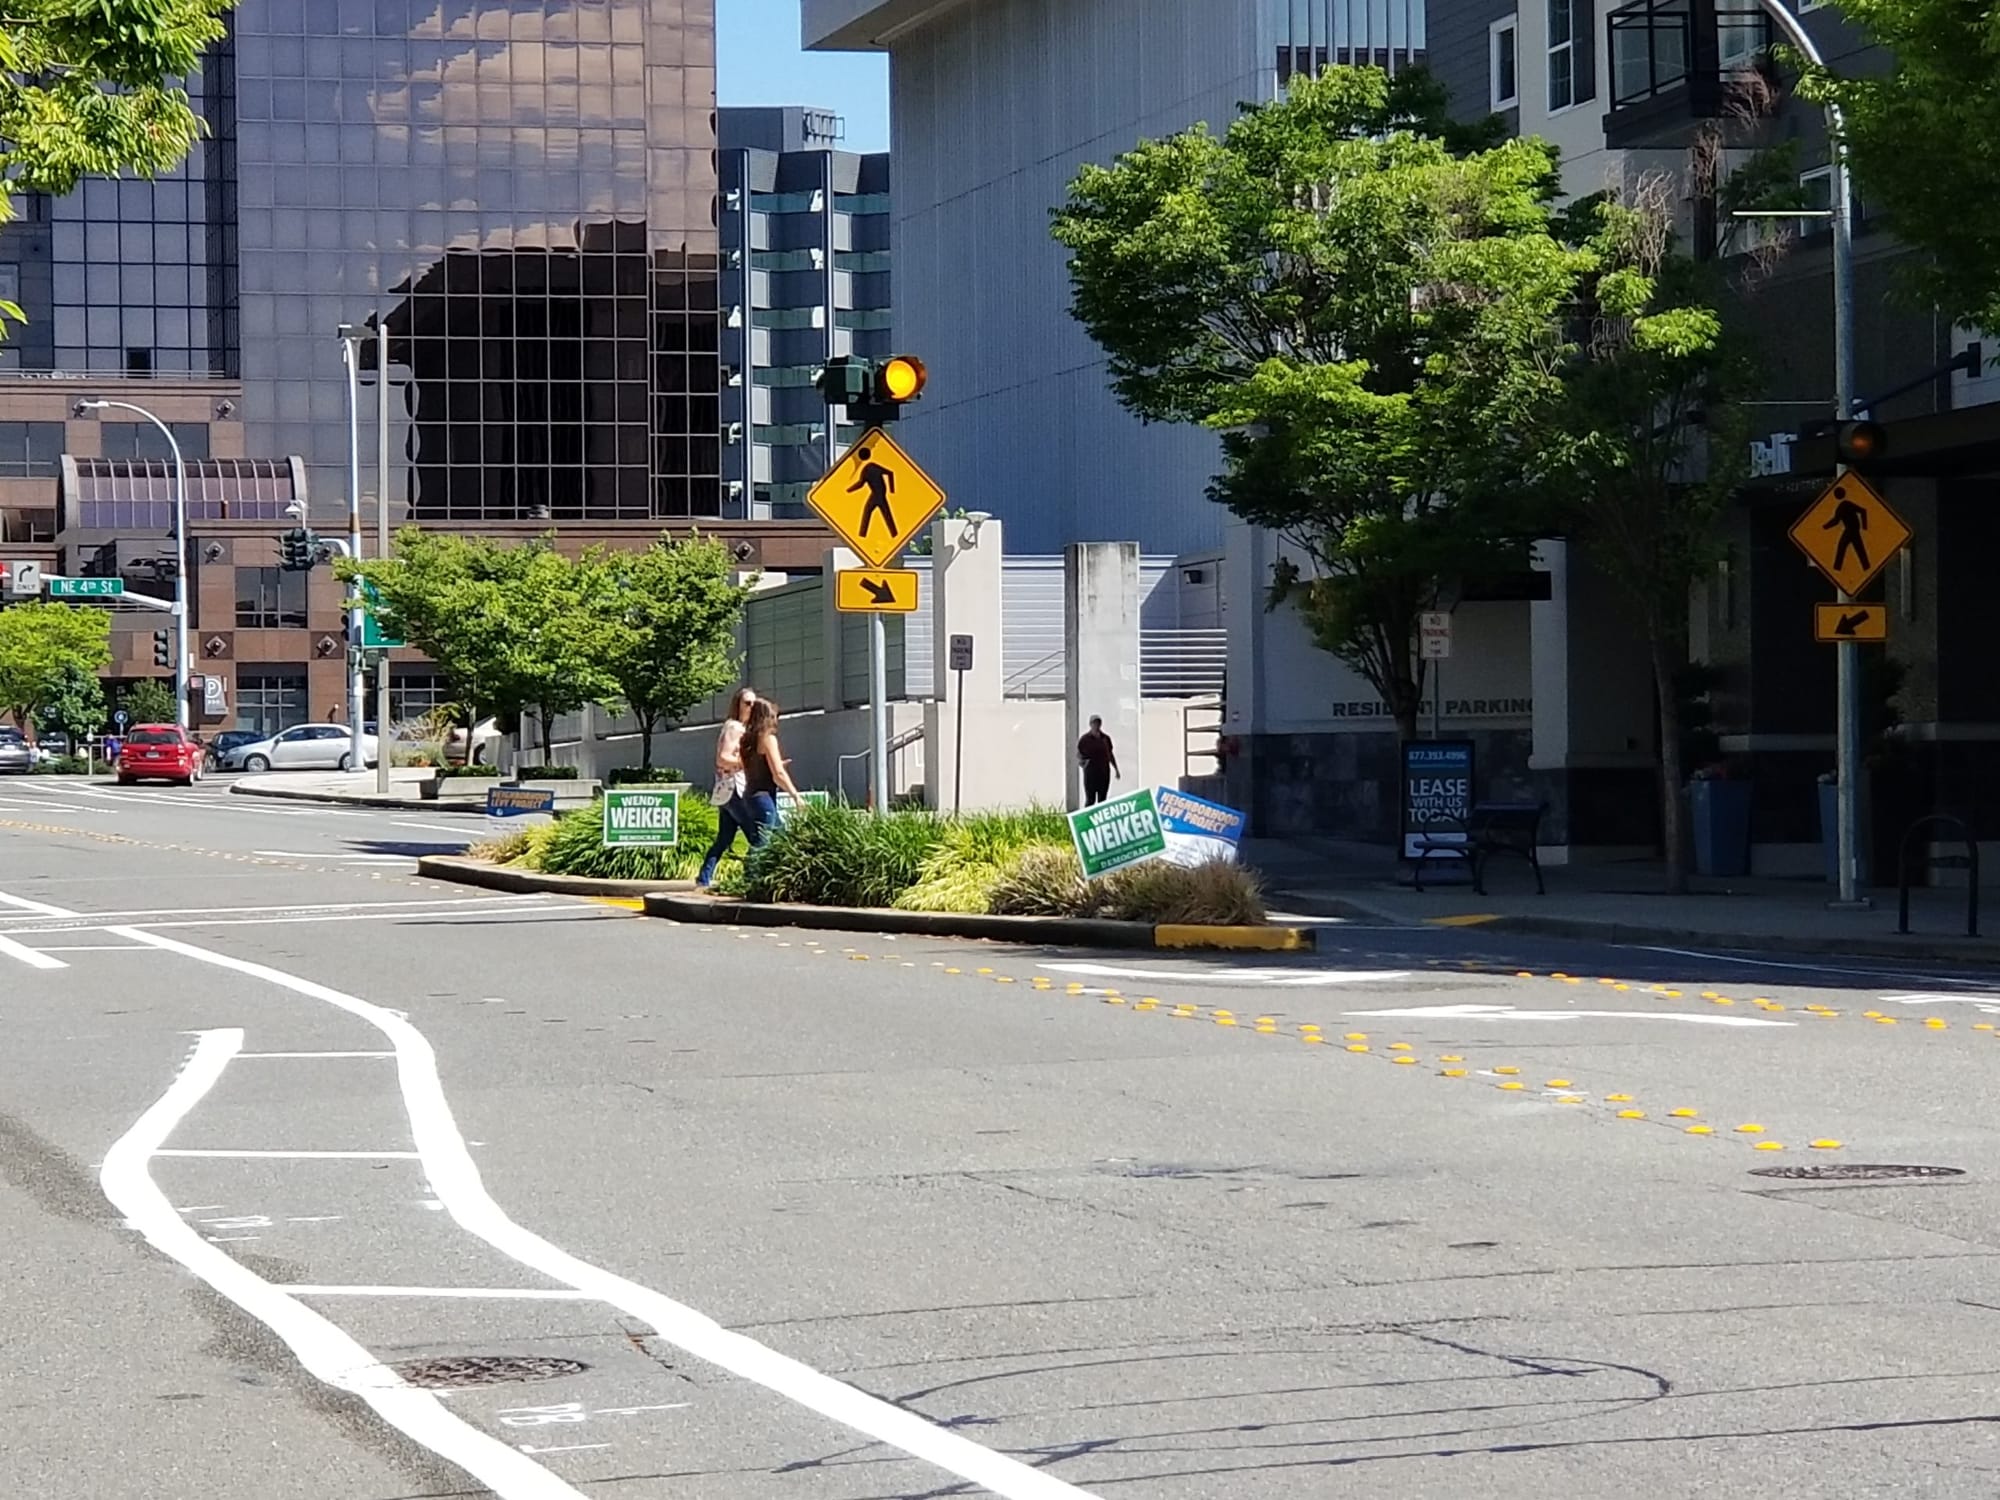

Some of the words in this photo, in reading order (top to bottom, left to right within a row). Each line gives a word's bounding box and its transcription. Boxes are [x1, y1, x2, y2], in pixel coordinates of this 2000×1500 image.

[60, 580, 76, 593] NE
[100, 580, 113, 593] St
[1332, 700, 1432, 717] RESIDNT
[1409, 778, 1468, 797] LEASE
[620, 795, 664, 807] WENDY
[1161, 792, 1240, 826] NEIGHBORHOOD
[1412, 797, 1443, 808] WITH
[1446, 796, 1463, 808] US
[610, 807, 673, 829] WEIKER
[1088, 800, 1137, 826] WENDY
[1159, 803, 1185, 819] LEVY
[1183, 809, 1227, 834] PROJECT
[1408, 808, 1467, 823] TODAY!
[1080, 809, 1158, 856] WEIKER
[1099, 846, 1151, 870] DEMOCRAT
